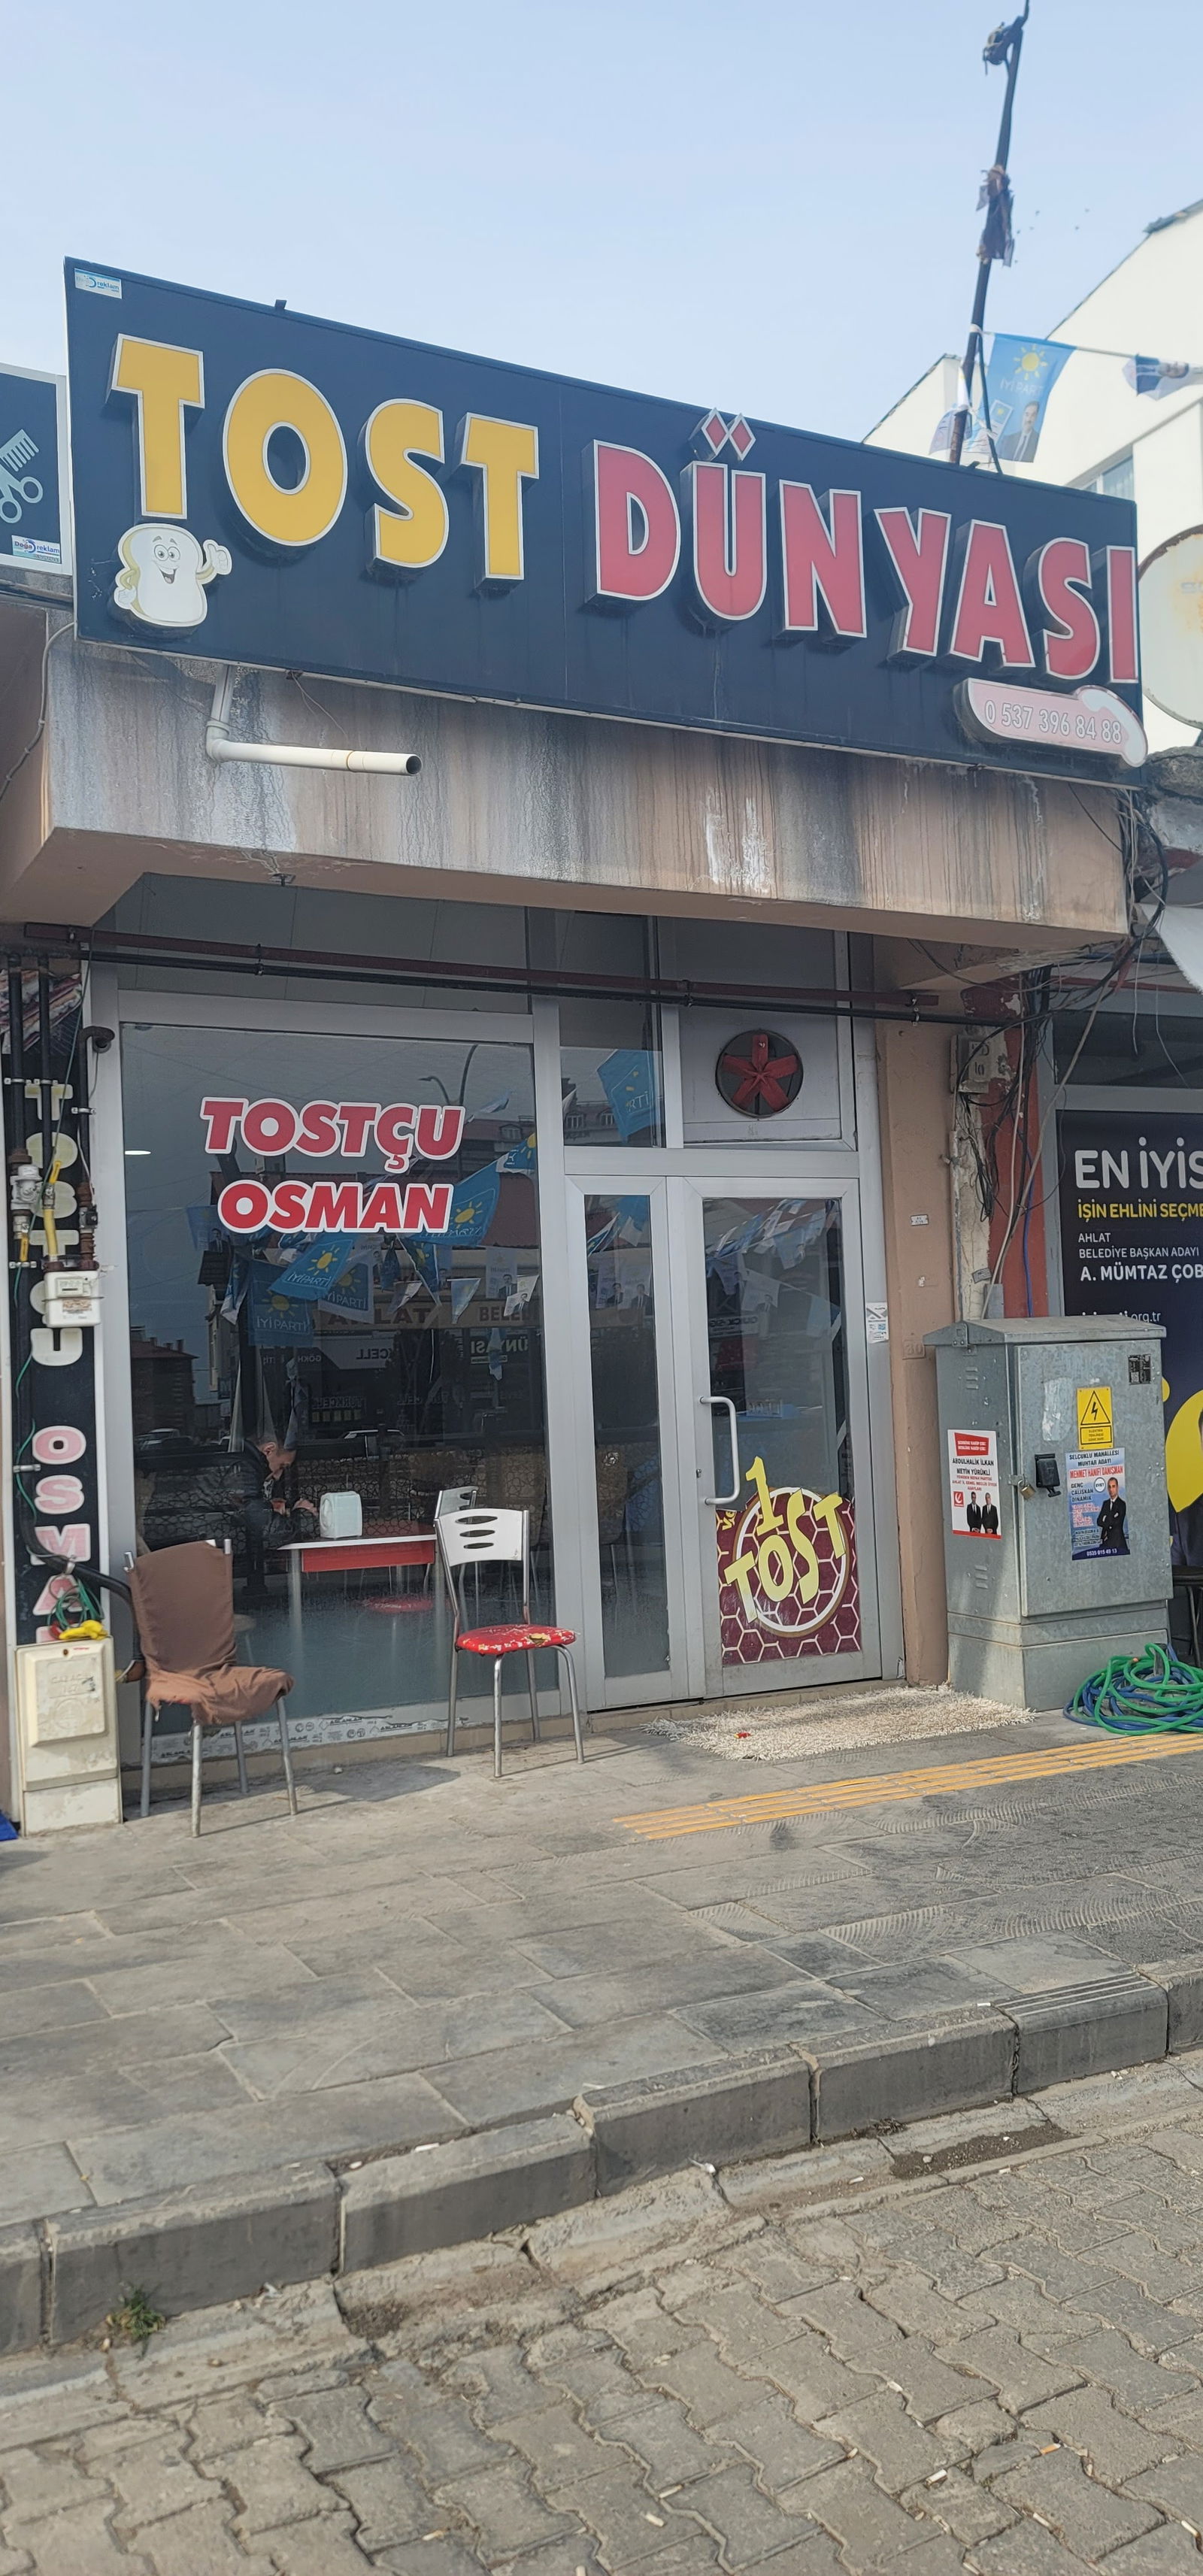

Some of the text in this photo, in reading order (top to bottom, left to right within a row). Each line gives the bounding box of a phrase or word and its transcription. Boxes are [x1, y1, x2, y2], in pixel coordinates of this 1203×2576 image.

[1016, 381, 1044, 396] PART
[109, 333, 1139, 685] TOST DÜNYASI
[37, 545, 60, 553] reklam
[985, 699, 1123, 744] 0 537 396 84 88
[200, 1096, 465, 1174] TOSTÇU
[1074, 1150, 1130, 1189] EN
[217, 1180, 453, 1234] OSMAN
[1077, 1199, 1107, 1223] İŞİN
[1109, 1198, 1157, 1219] EHLİNİ
[1078, 1232, 1111, 1243] AHLAT
[1079, 1245, 1200, 1260] BELEDİYE BAŞKAN ADAYI
[302, 1274, 332, 1287] PARTİ
[1080, 1262, 1203, 1283] A. MÜMTAZ ÇOB
[336, 1294, 367, 1310] PARTİ
[256, 1316, 307, 1332] İYİ PARTİ
[328, 1308, 432, 1325] ALAT
[1070, 1468, 1087, 1478] MEHMET
[745, 1456, 784, 1536] 1
[30, 1425, 91, 1644] OSMA
[724, 1488, 846, 1623] TOST
